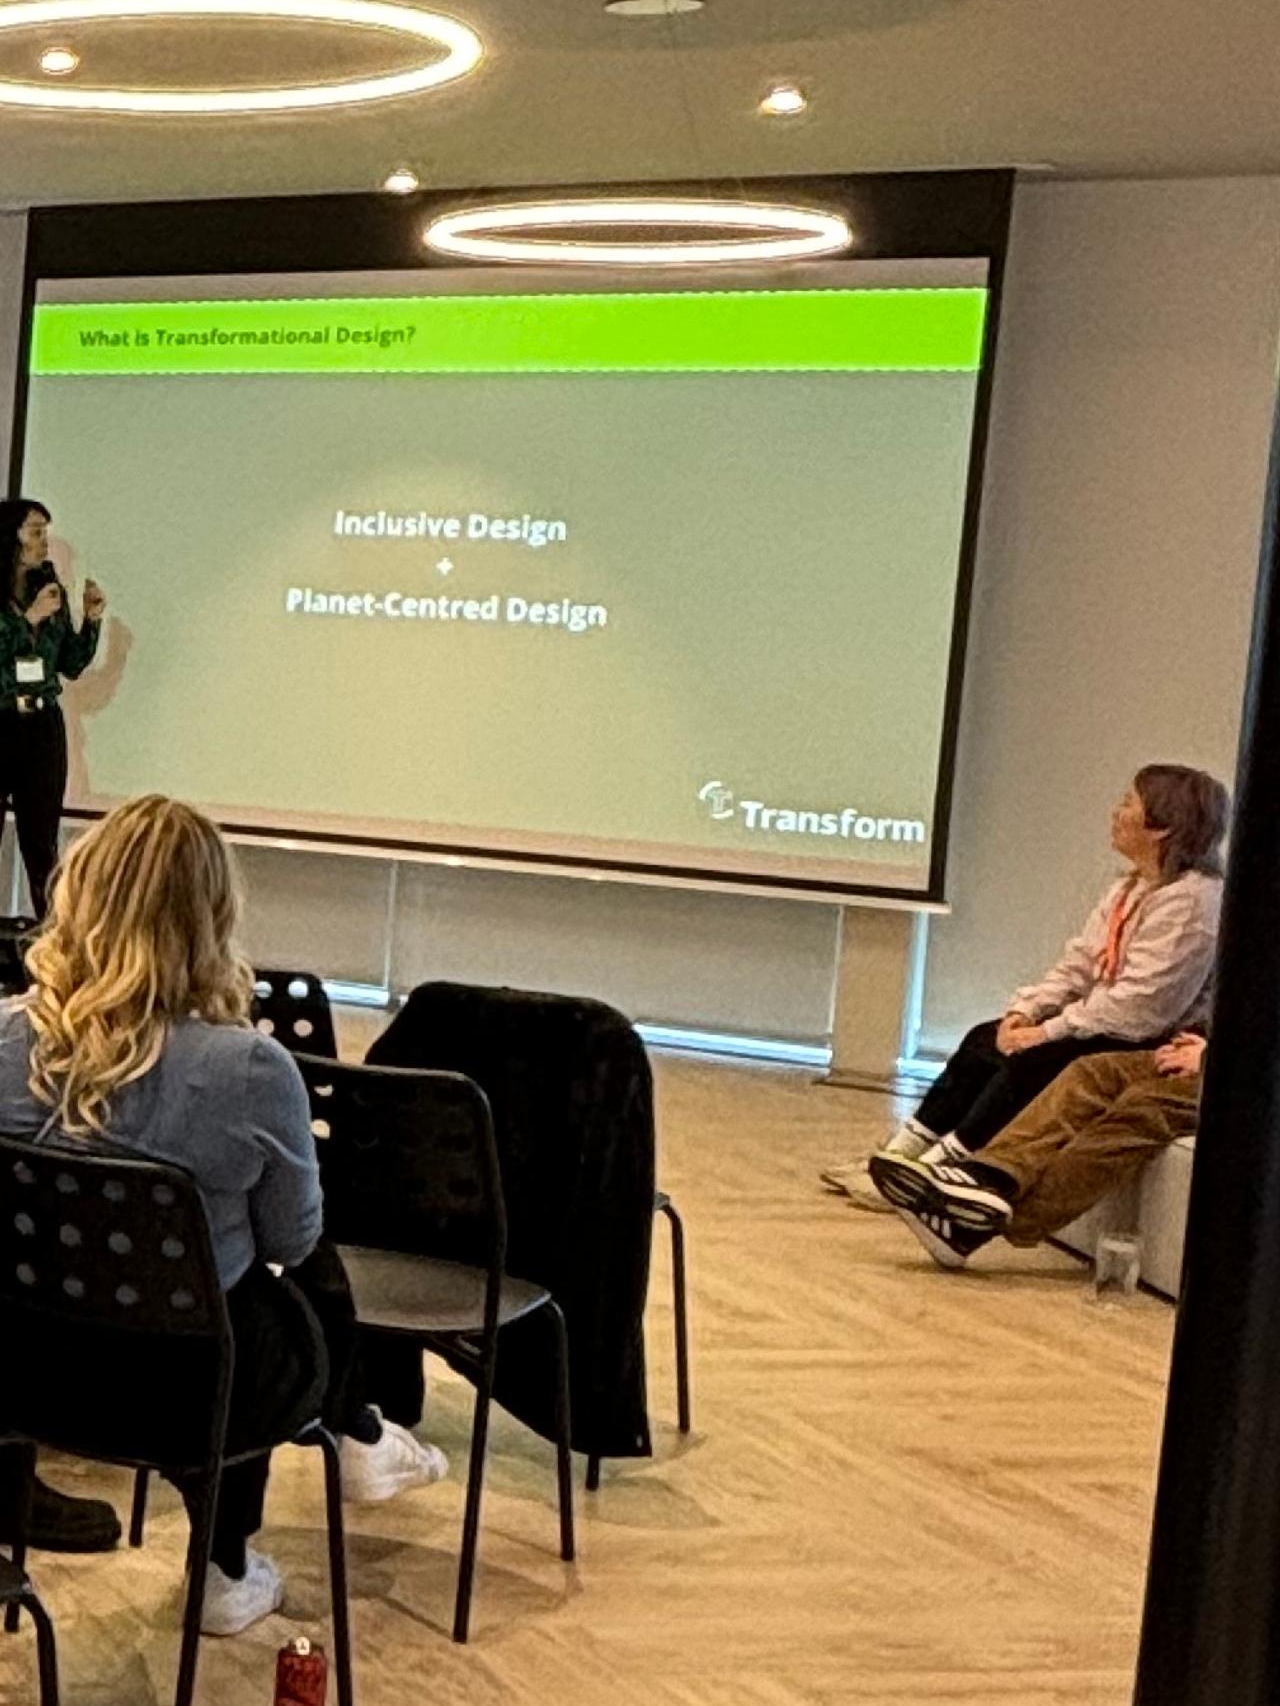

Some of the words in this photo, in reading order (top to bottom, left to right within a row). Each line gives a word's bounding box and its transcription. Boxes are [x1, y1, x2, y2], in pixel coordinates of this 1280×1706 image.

[79, 329, 130, 347] What
[155, 327, 331, 346] Transformational
[336, 326, 417, 348] Design?
[333, 509, 460, 539] Inclusive
[466, 513, 568, 547] Design
[285, 587, 500, 621] Planet-Centred
[506, 597, 609, 633] Design
[739, 800, 926, 843] Transform
